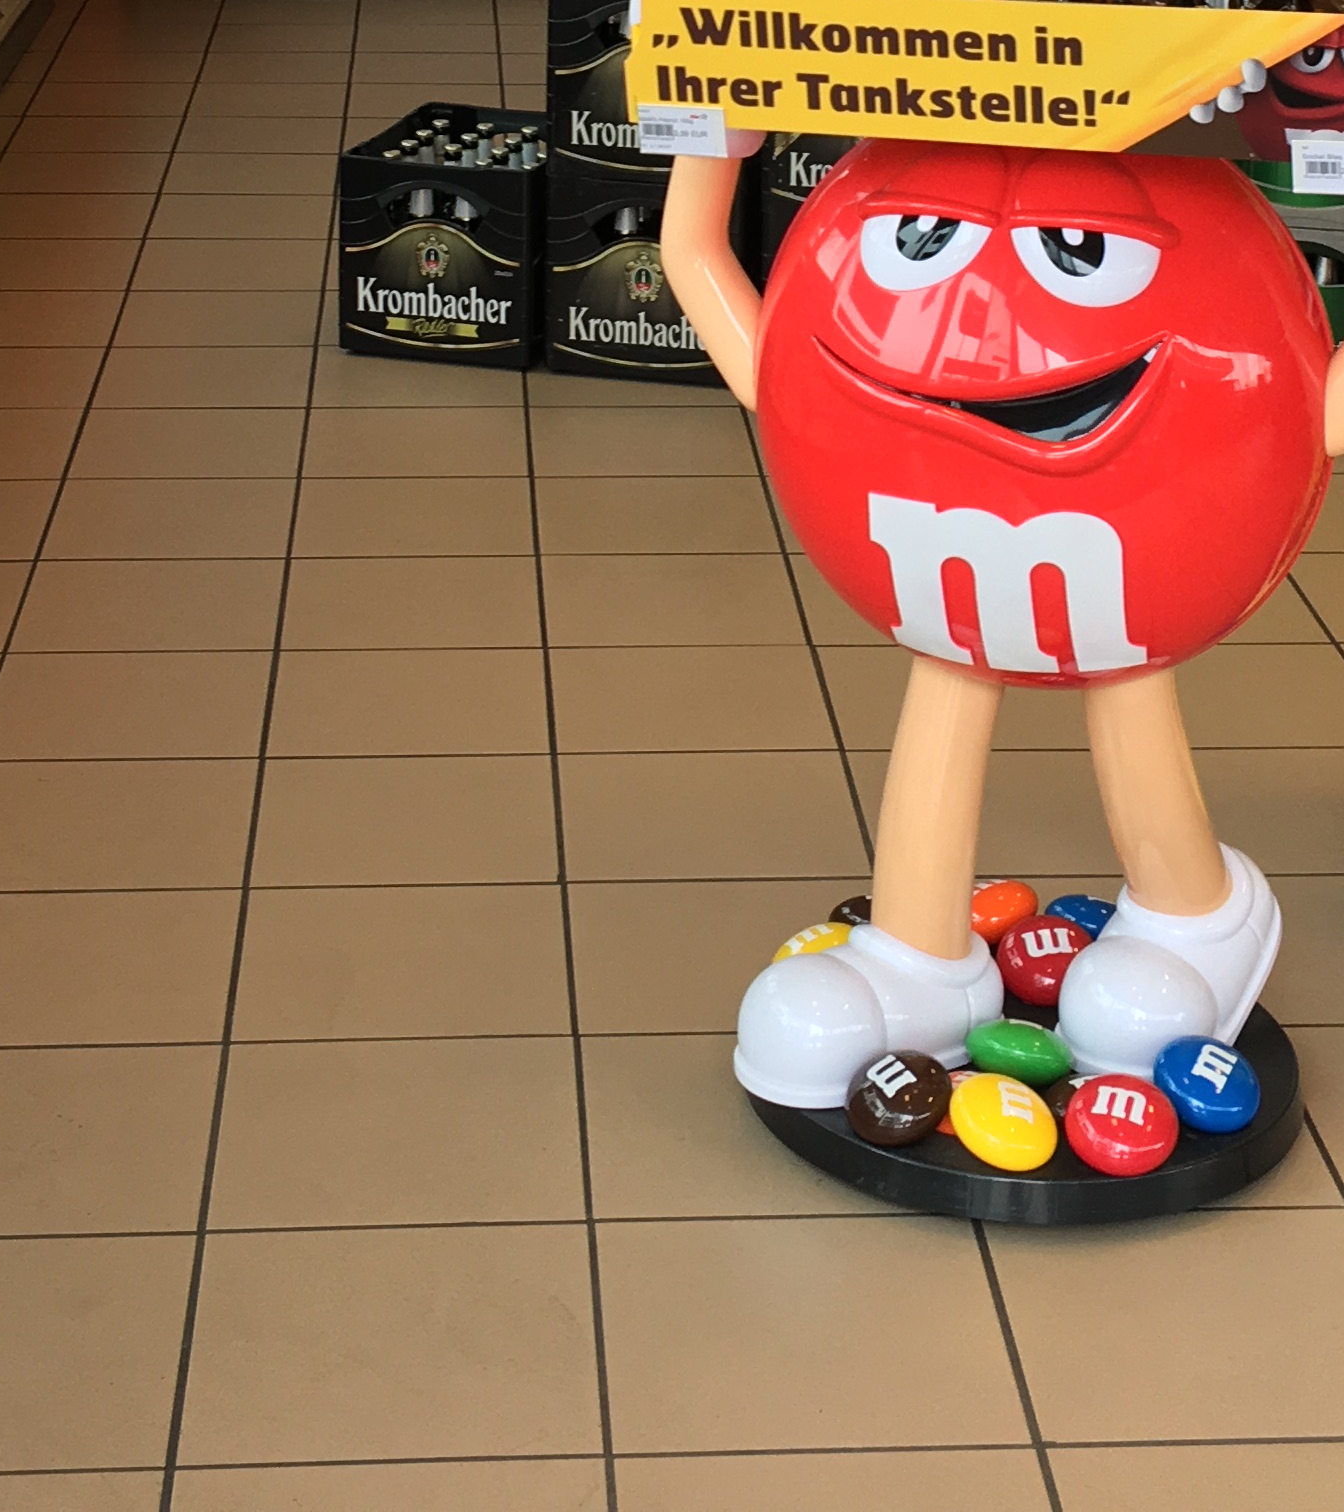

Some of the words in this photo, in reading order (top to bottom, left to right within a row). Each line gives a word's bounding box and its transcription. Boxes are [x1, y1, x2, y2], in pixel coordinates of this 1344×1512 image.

[651, 6, 1018, 65] „Willkommen
[1034, 26, 1084, 67] in
[657, 65, 783, 108] Ihrer
[570, 112, 642, 149] Krom
[789, 151, 833, 188] Kro
[356, 276, 513, 326] Krombacher
[868, 491, 1148, 674] m
